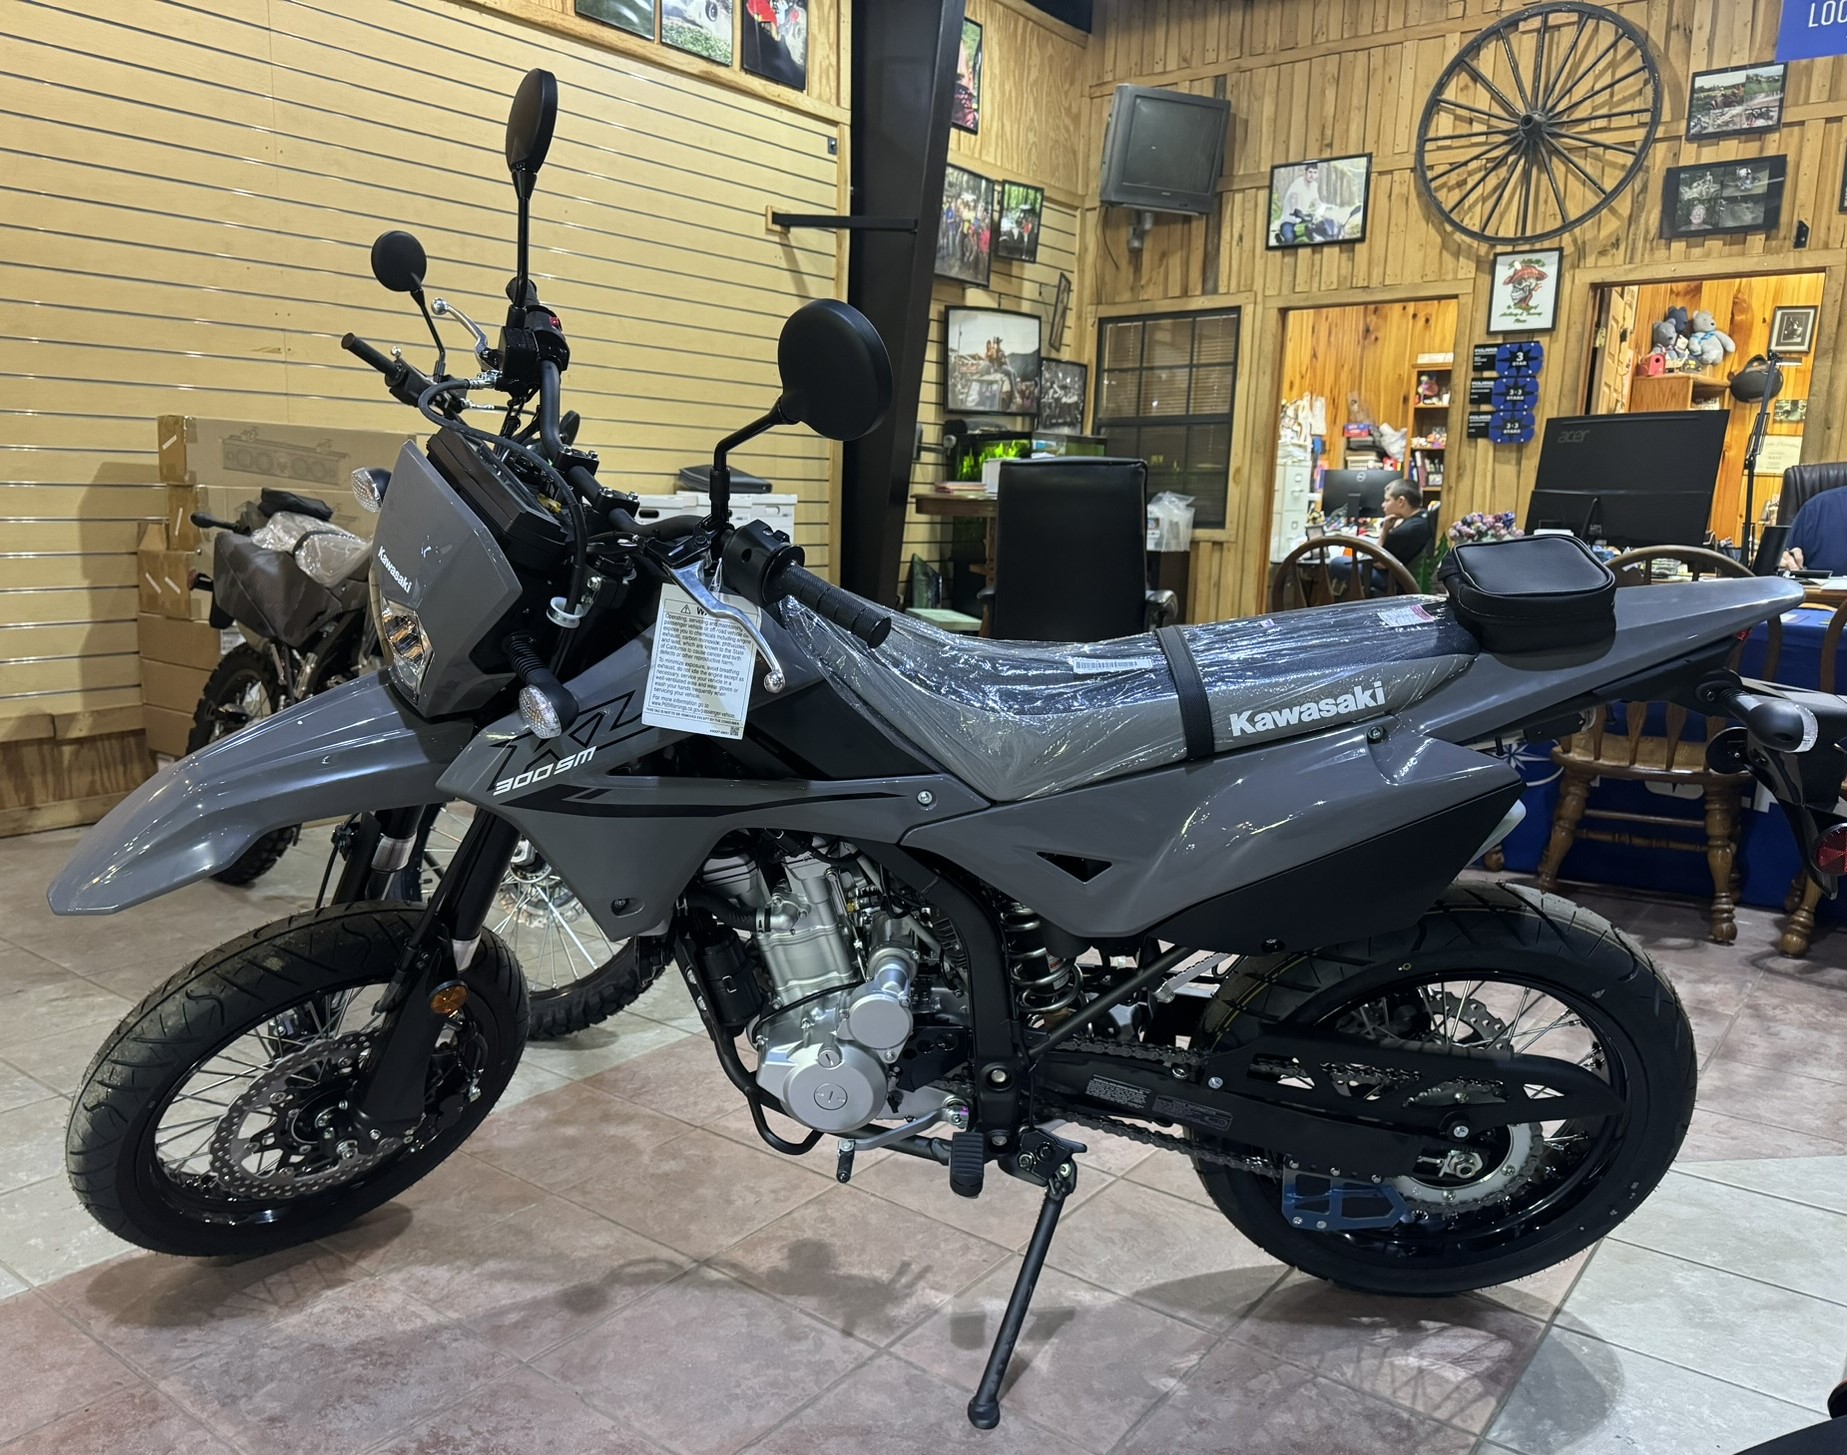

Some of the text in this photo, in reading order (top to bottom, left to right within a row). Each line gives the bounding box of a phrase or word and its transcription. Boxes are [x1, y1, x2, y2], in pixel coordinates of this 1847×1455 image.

[1516, 352, 1524, 361] 3
[1558, 430, 1590, 444] acer
[378, 546, 412, 594] Kawasaki
[1230, 681, 1386, 736] Kawasaki
